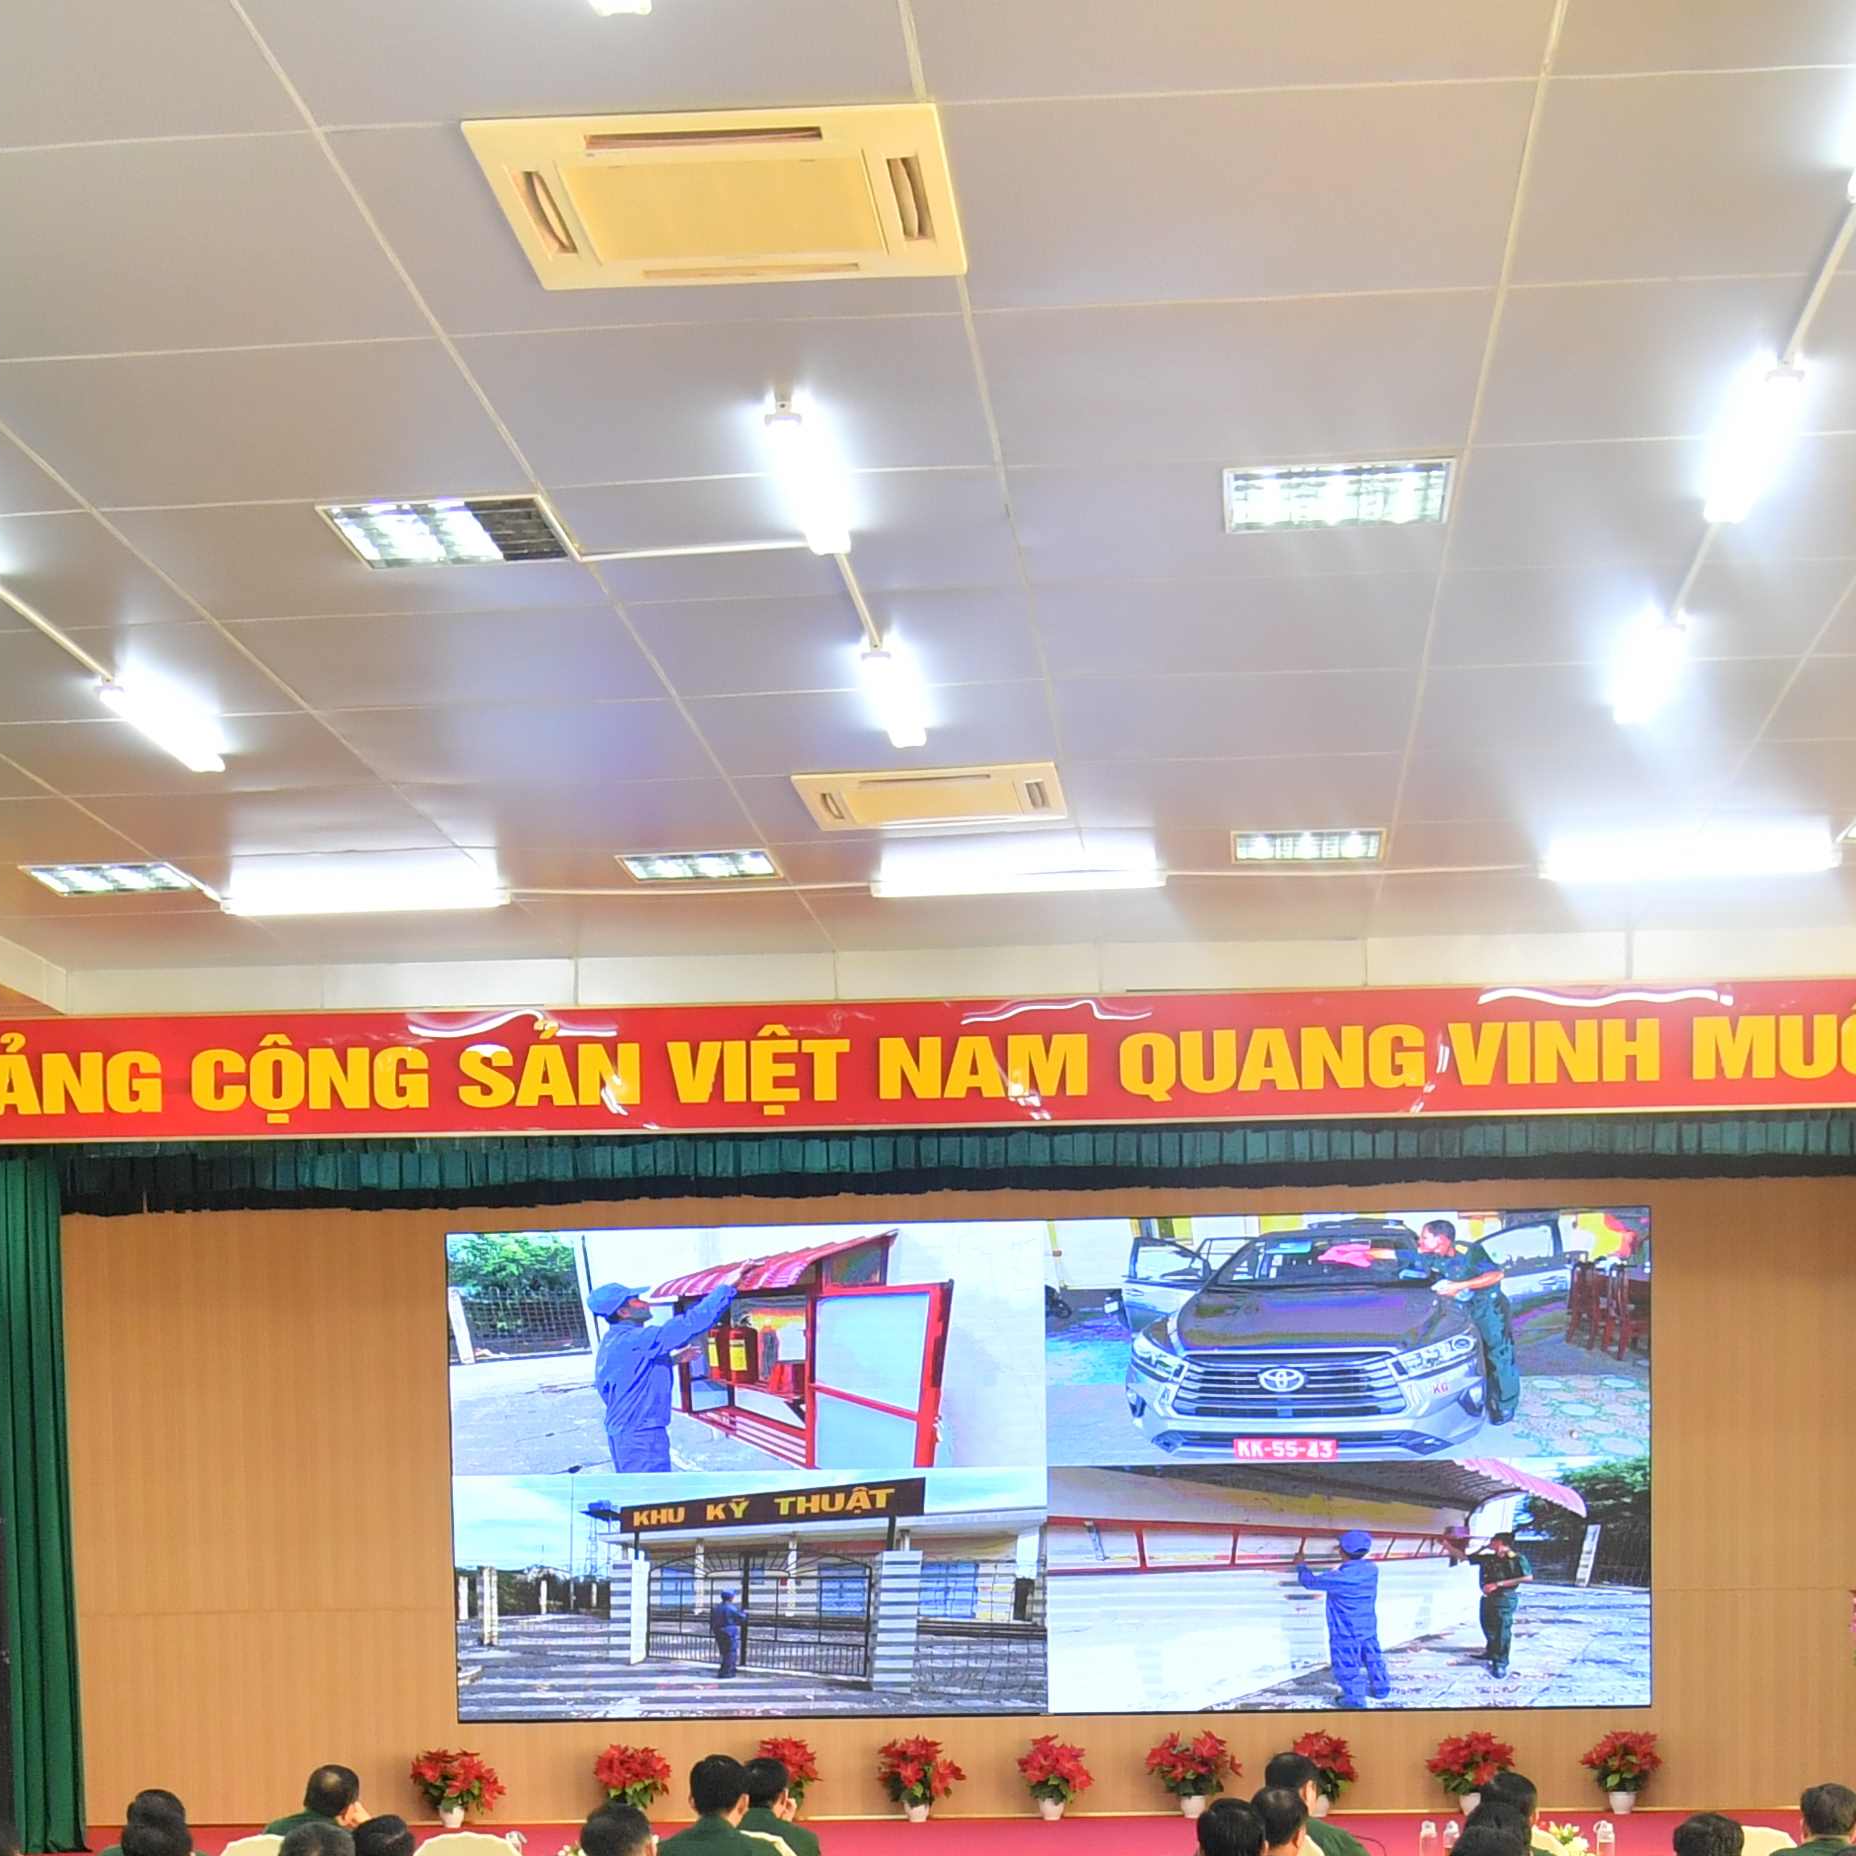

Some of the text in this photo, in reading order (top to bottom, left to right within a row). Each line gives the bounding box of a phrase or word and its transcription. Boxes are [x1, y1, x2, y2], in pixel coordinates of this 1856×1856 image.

[191, 1035, 429, 1123] CỘNG
[457, 1018, 644, 1110] SẢN
[666, 1023, 851, 1116] VIỆT
[879, 1033, 1089, 1101] NAM
[1118, 1022, 1425, 1103] QUANG
[1447, 1014, 1669, 1087] VINH
[633, 1486, 895, 1527] KHU KỸ THUẬT
